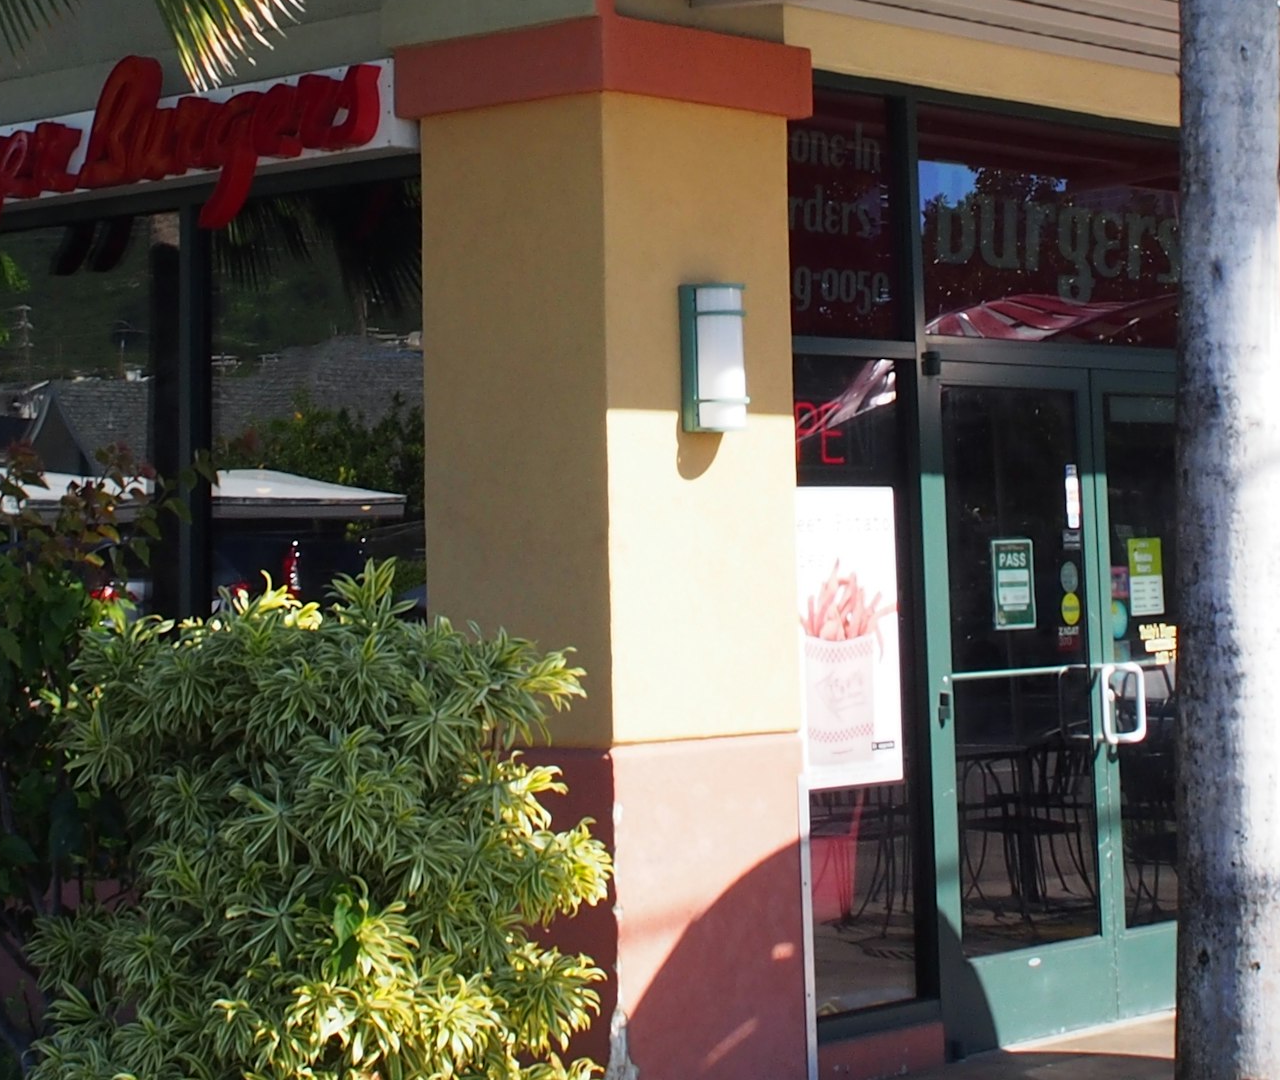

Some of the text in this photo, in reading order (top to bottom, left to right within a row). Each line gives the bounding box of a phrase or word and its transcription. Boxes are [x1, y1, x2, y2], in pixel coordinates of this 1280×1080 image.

[77, 55, 382, 230] Burgers
[791, 123, 882, 173] one-In
[789, 184, 873, 239] rders
[999, 552, 1027, 568] PASS
